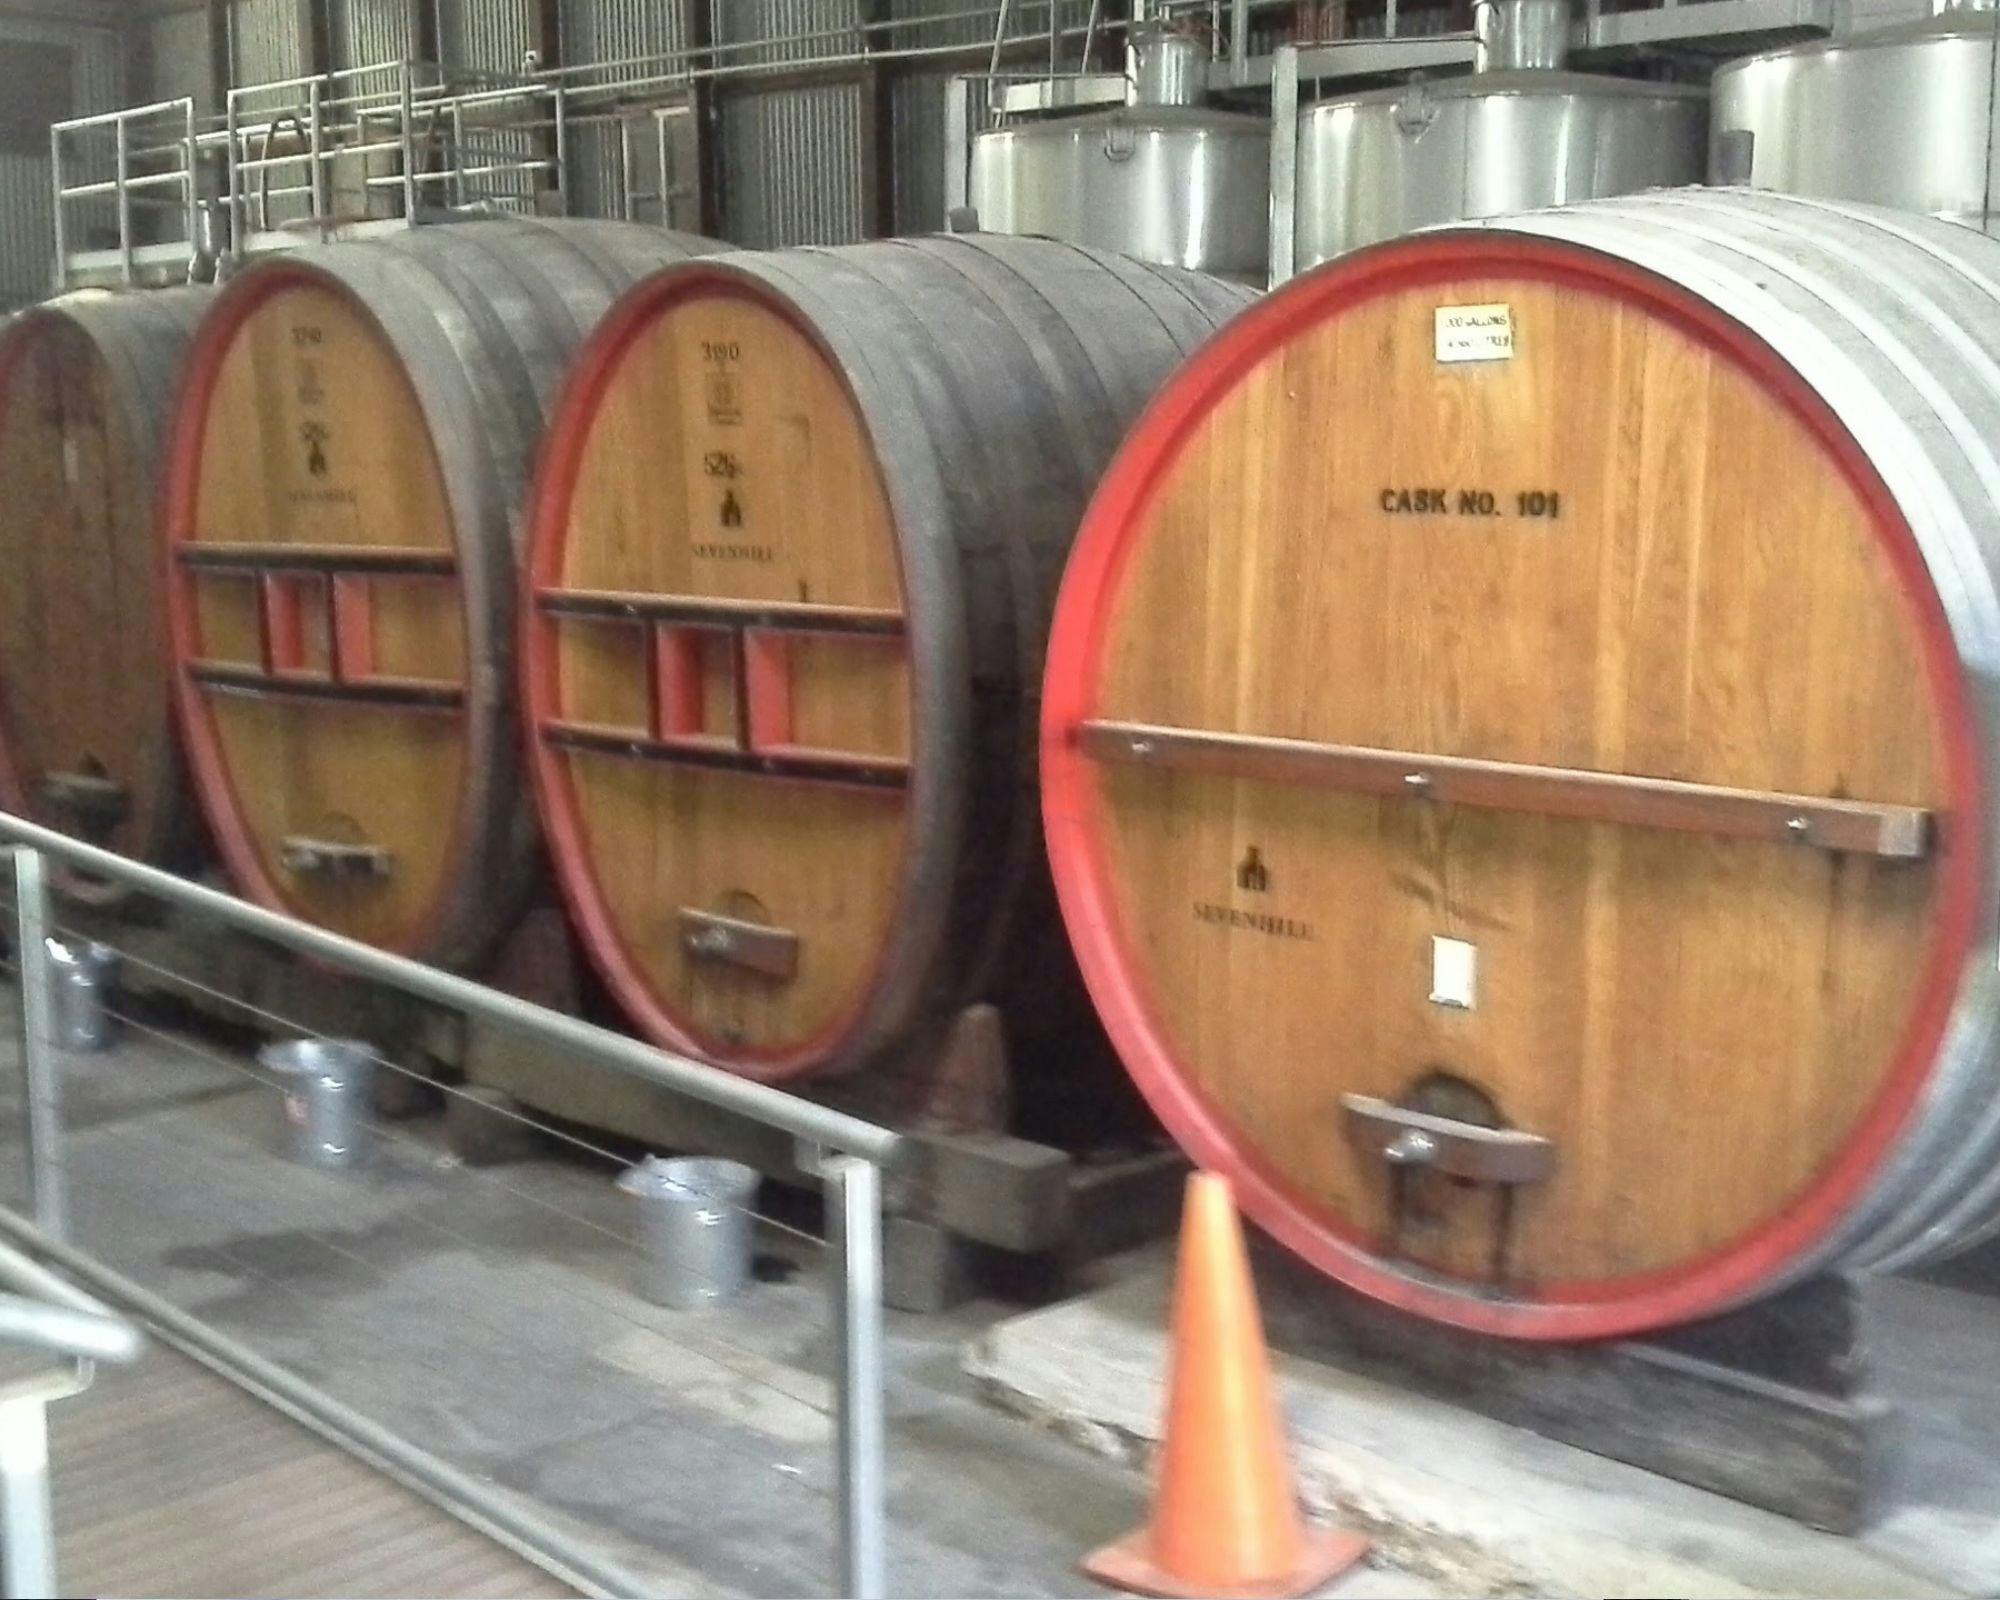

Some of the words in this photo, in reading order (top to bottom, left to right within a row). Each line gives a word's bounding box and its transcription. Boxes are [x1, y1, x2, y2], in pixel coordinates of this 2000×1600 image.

[1382, 487, 1447, 514] CASK
[1459, 489, 1500, 517] NO.
[1517, 489, 1559, 518] 101
[1193, 901, 1312, 940] SEVENHILL
